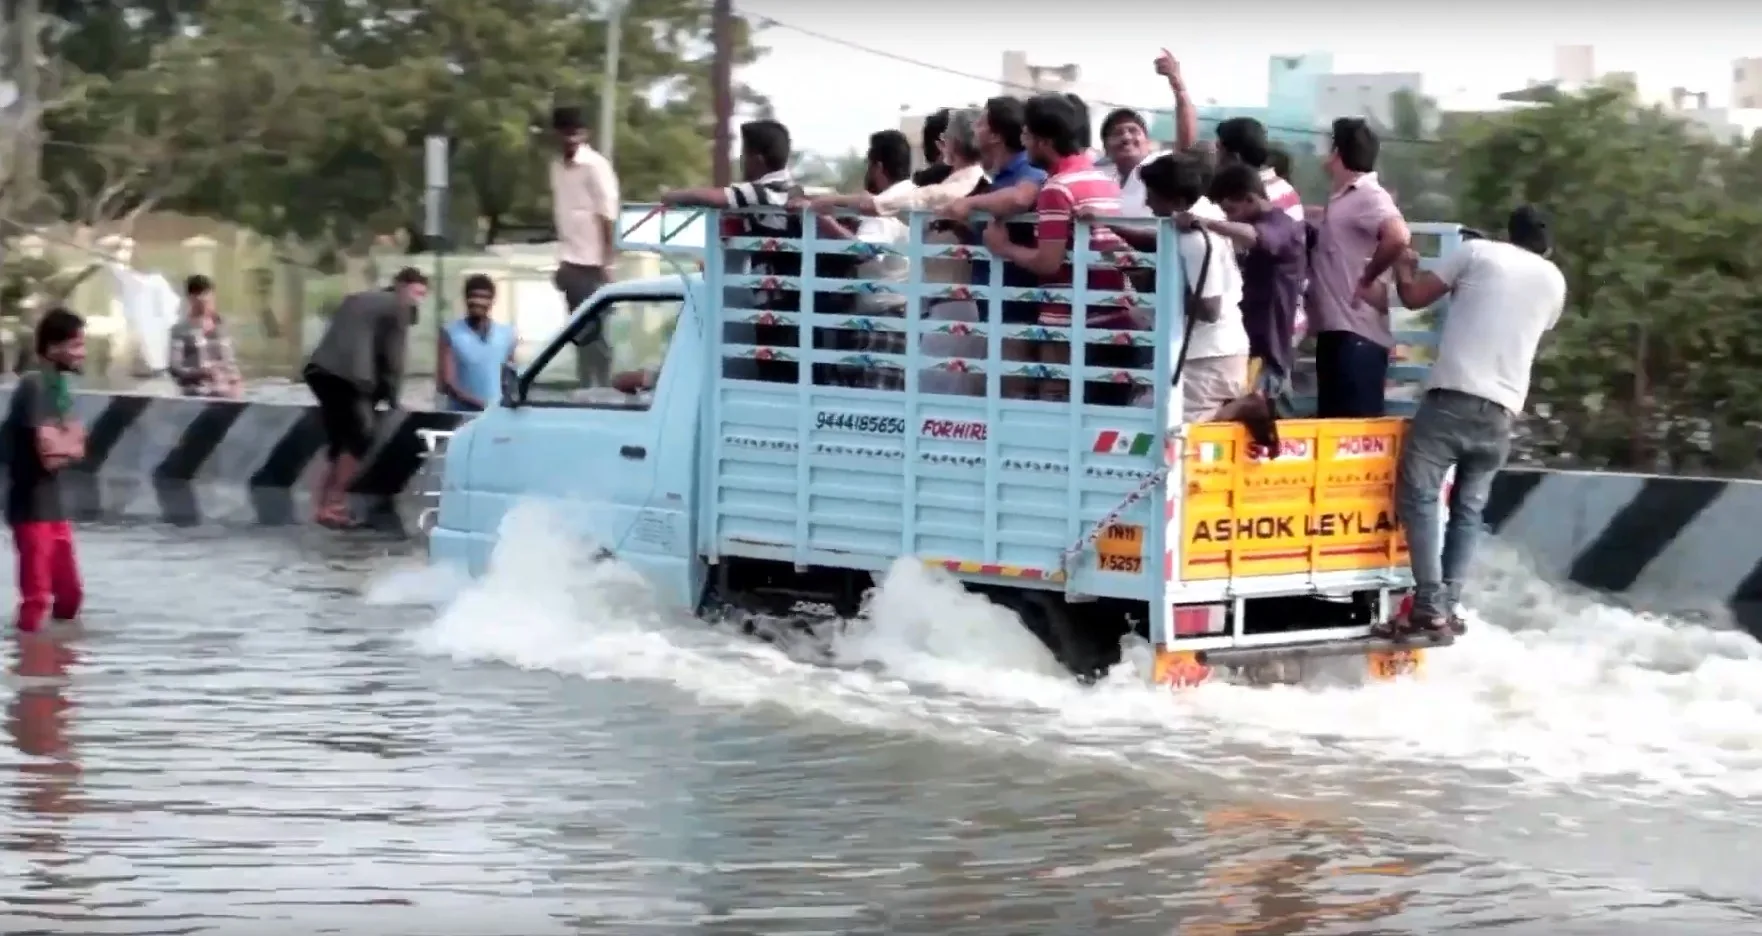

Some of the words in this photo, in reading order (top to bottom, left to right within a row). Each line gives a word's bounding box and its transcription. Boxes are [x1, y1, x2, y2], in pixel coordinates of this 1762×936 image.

[1245, 438, 1308, 460] SOND
[1337, 436, 1385, 455] HORN
[1192, 516, 1295, 543] ASHOK
